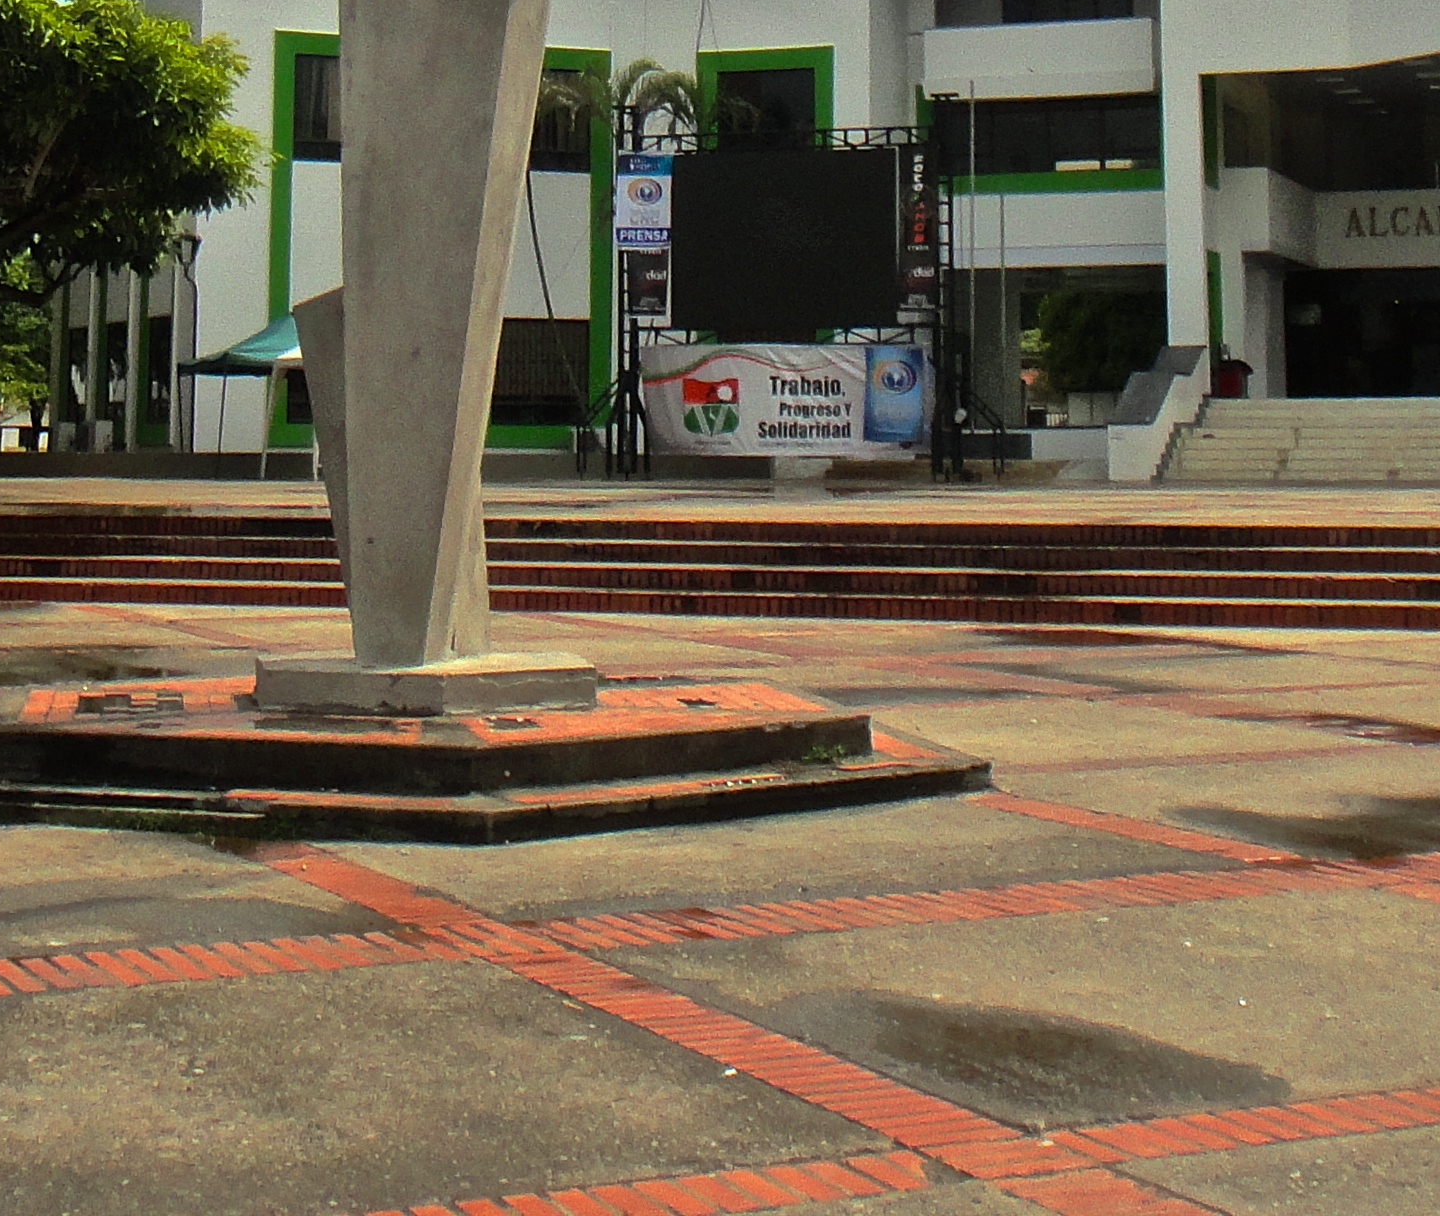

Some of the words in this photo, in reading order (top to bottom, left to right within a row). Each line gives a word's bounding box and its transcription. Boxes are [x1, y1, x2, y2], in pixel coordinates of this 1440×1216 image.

[619, 229, 669, 242] PRENSA
[779, 402, 842, 418] Progreso
[844, 402, 852, 417] Y
[757, 420, 852, 439] Solidaridad
